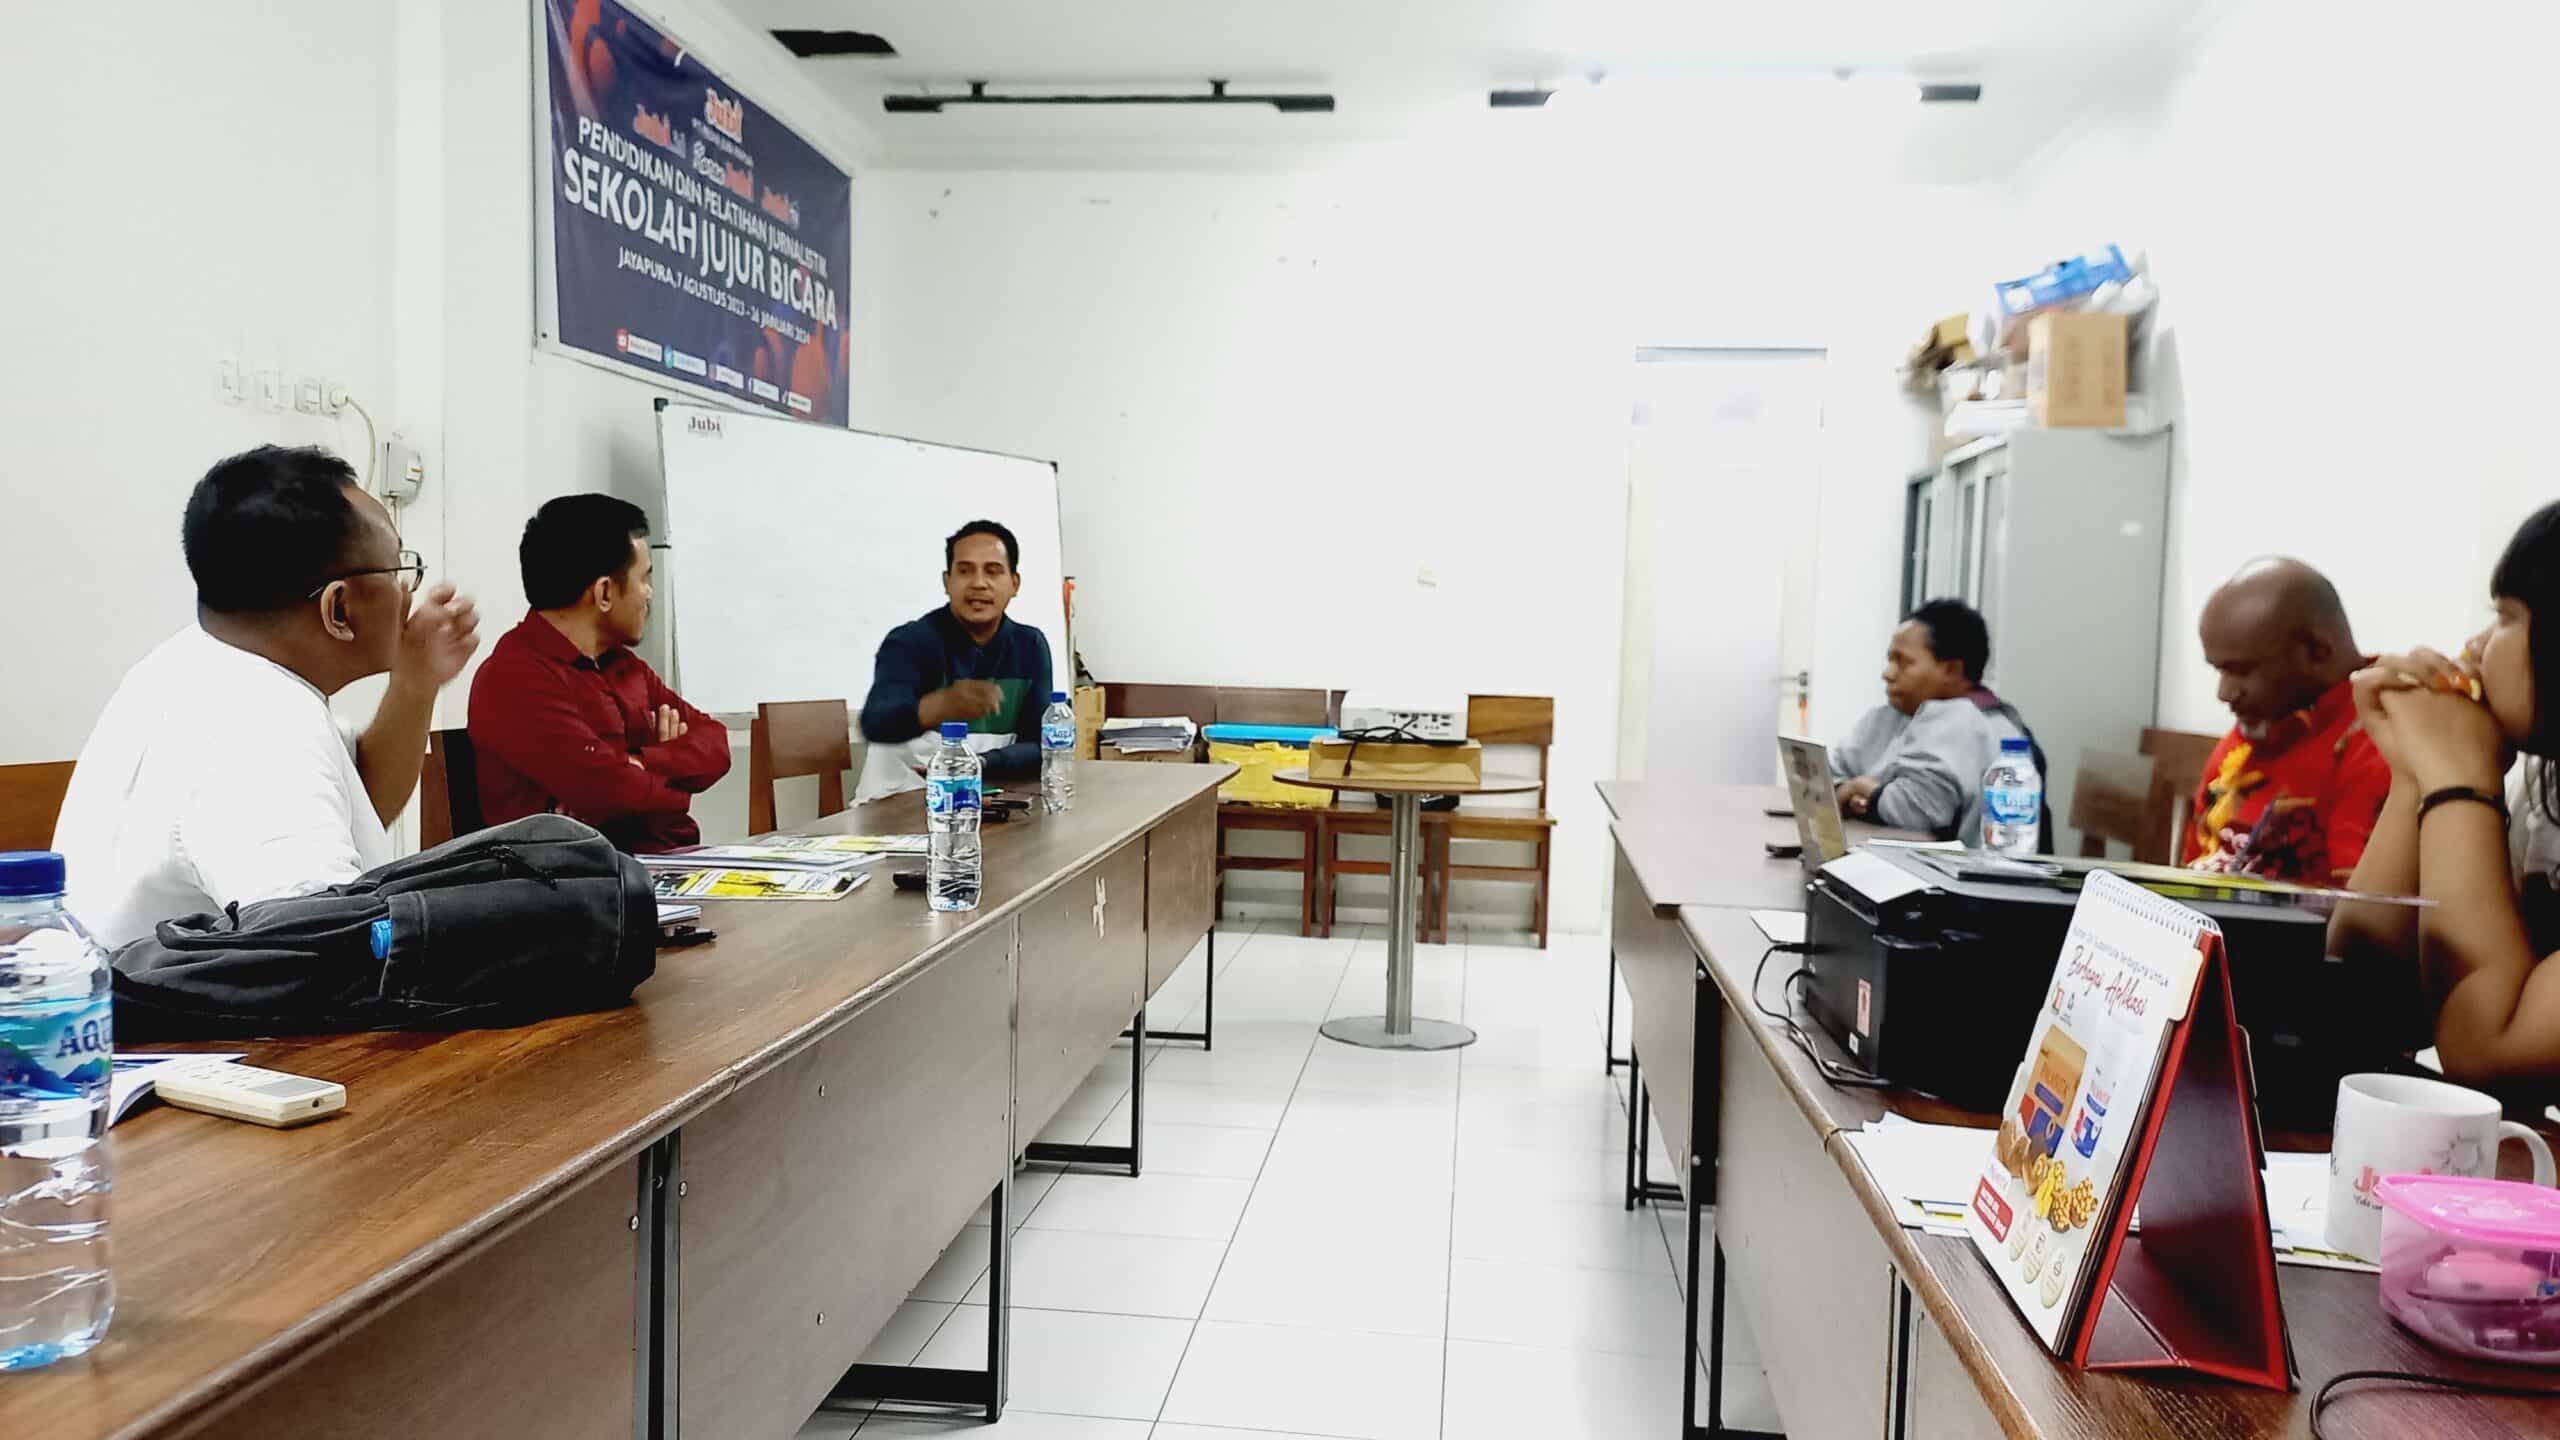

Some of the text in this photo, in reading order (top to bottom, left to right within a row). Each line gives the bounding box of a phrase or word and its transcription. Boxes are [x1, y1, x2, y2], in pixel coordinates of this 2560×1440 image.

[578, 115, 674, 190] PENDIDIKAN
[674, 169, 703, 207] DAN
[704, 186, 767, 243] PELATIHAN
[767, 223, 828, 279] JURNALISTIK
[564, 146, 698, 260] SEKOLAH
[700, 219, 765, 294] JUJUR
[769, 254, 838, 331] BICARA
[683, 275, 727, 308] AGUSTUS
[688, 415, 721, 432] Jubi
[55, 1015, 112, 1059] AQU
